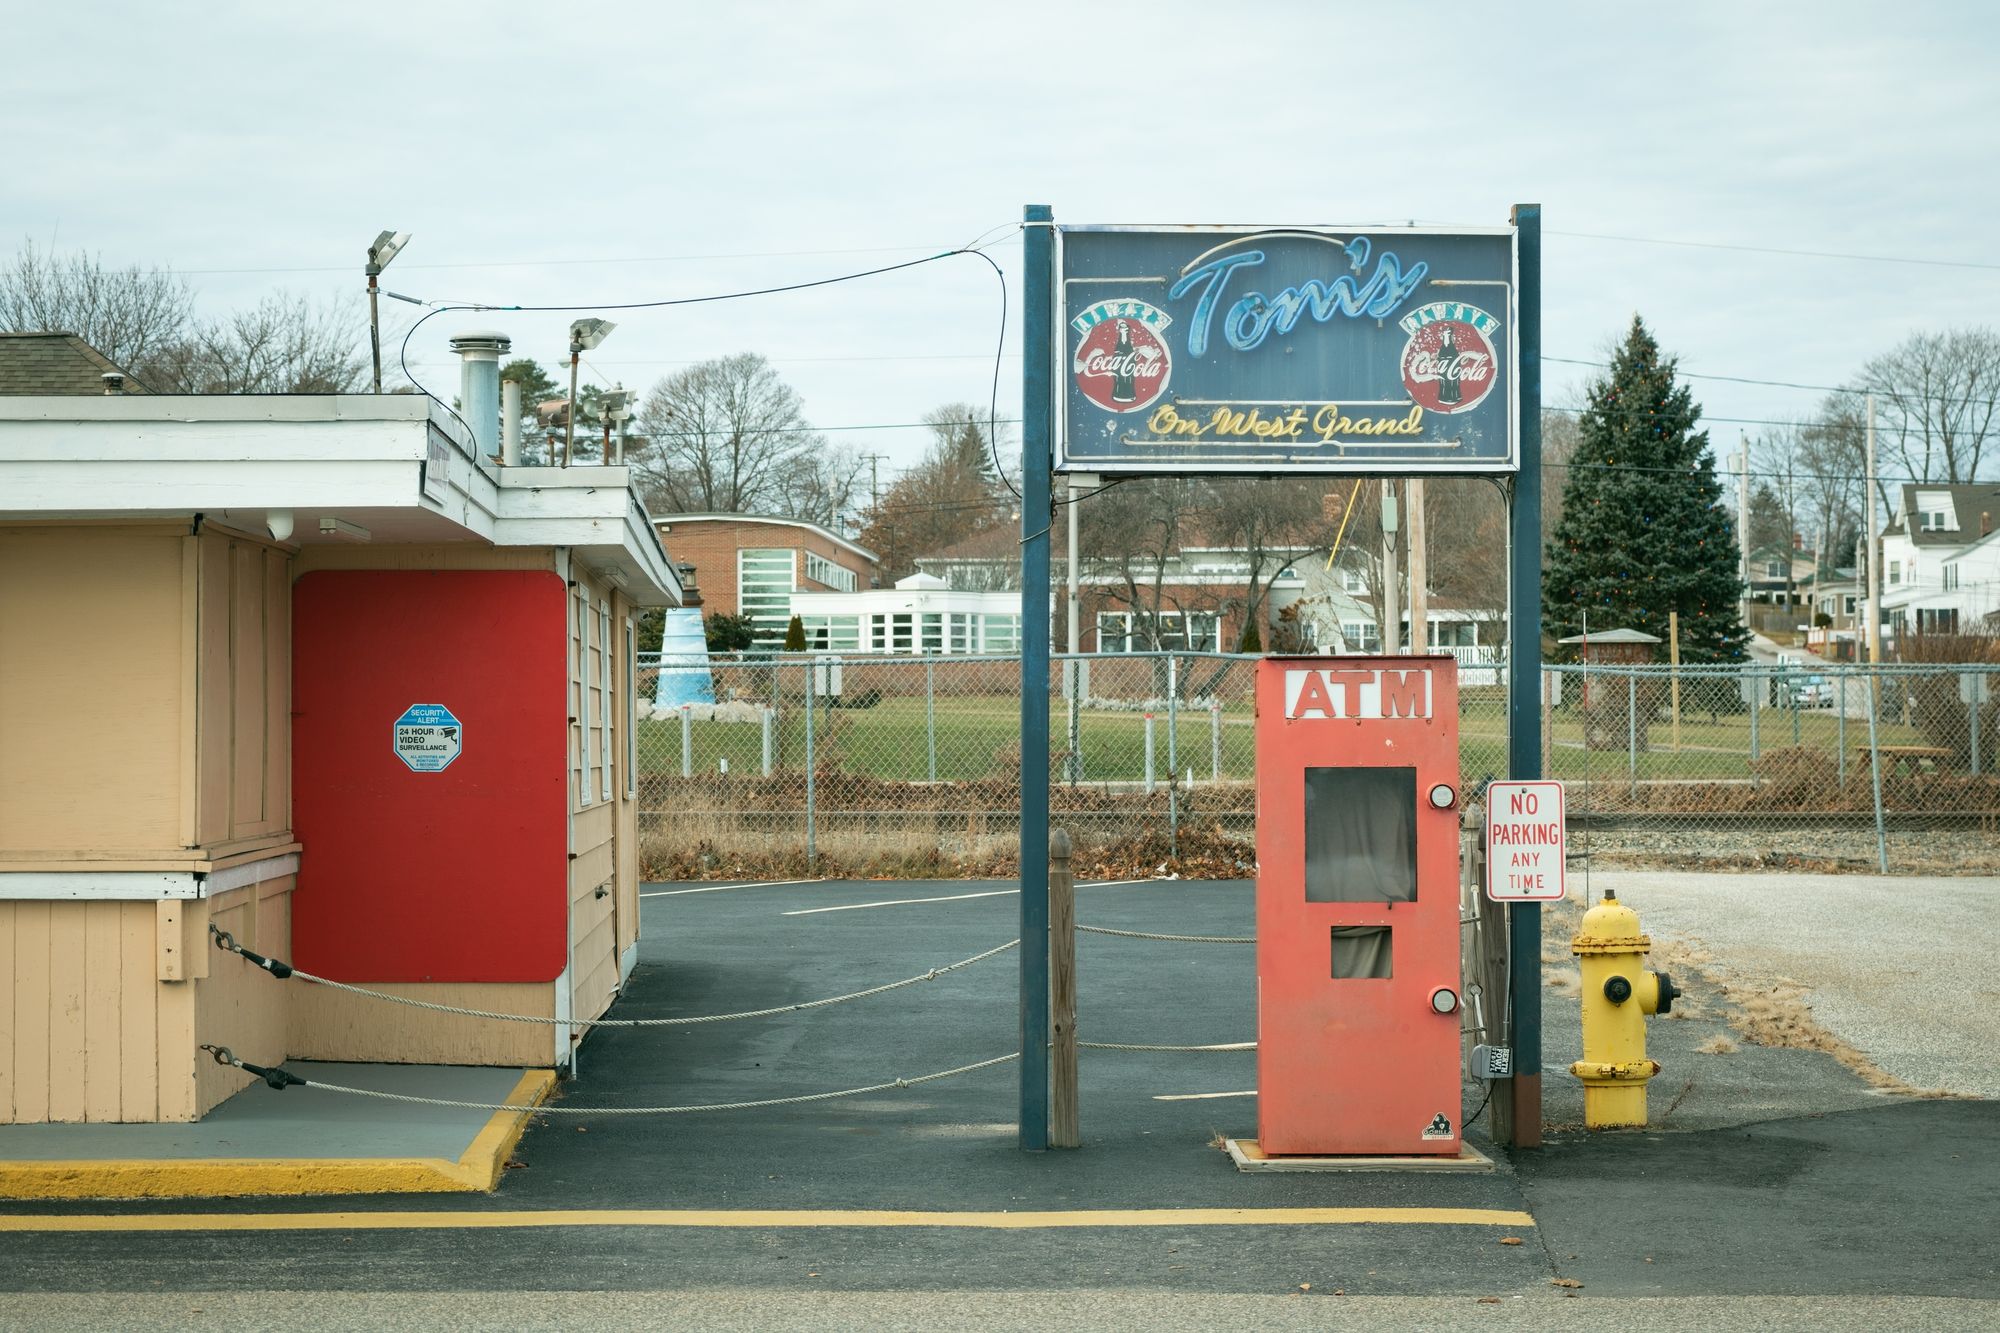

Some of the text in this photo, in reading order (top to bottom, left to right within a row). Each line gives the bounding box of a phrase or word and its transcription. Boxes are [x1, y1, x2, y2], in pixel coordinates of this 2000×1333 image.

[1168, 237, 1428, 358] Tom's
[1150, 404, 1425, 441] On West Grand
[1293, 671, 1426, 717] ATM
[399, 728, 435, 736] 24 HOUR
[1511, 793, 1538, 815] NO
[1493, 823, 1559, 845] PARKING
[1511, 852, 1540, 867] ANY
[1509, 874, 1545, 889] TIME
